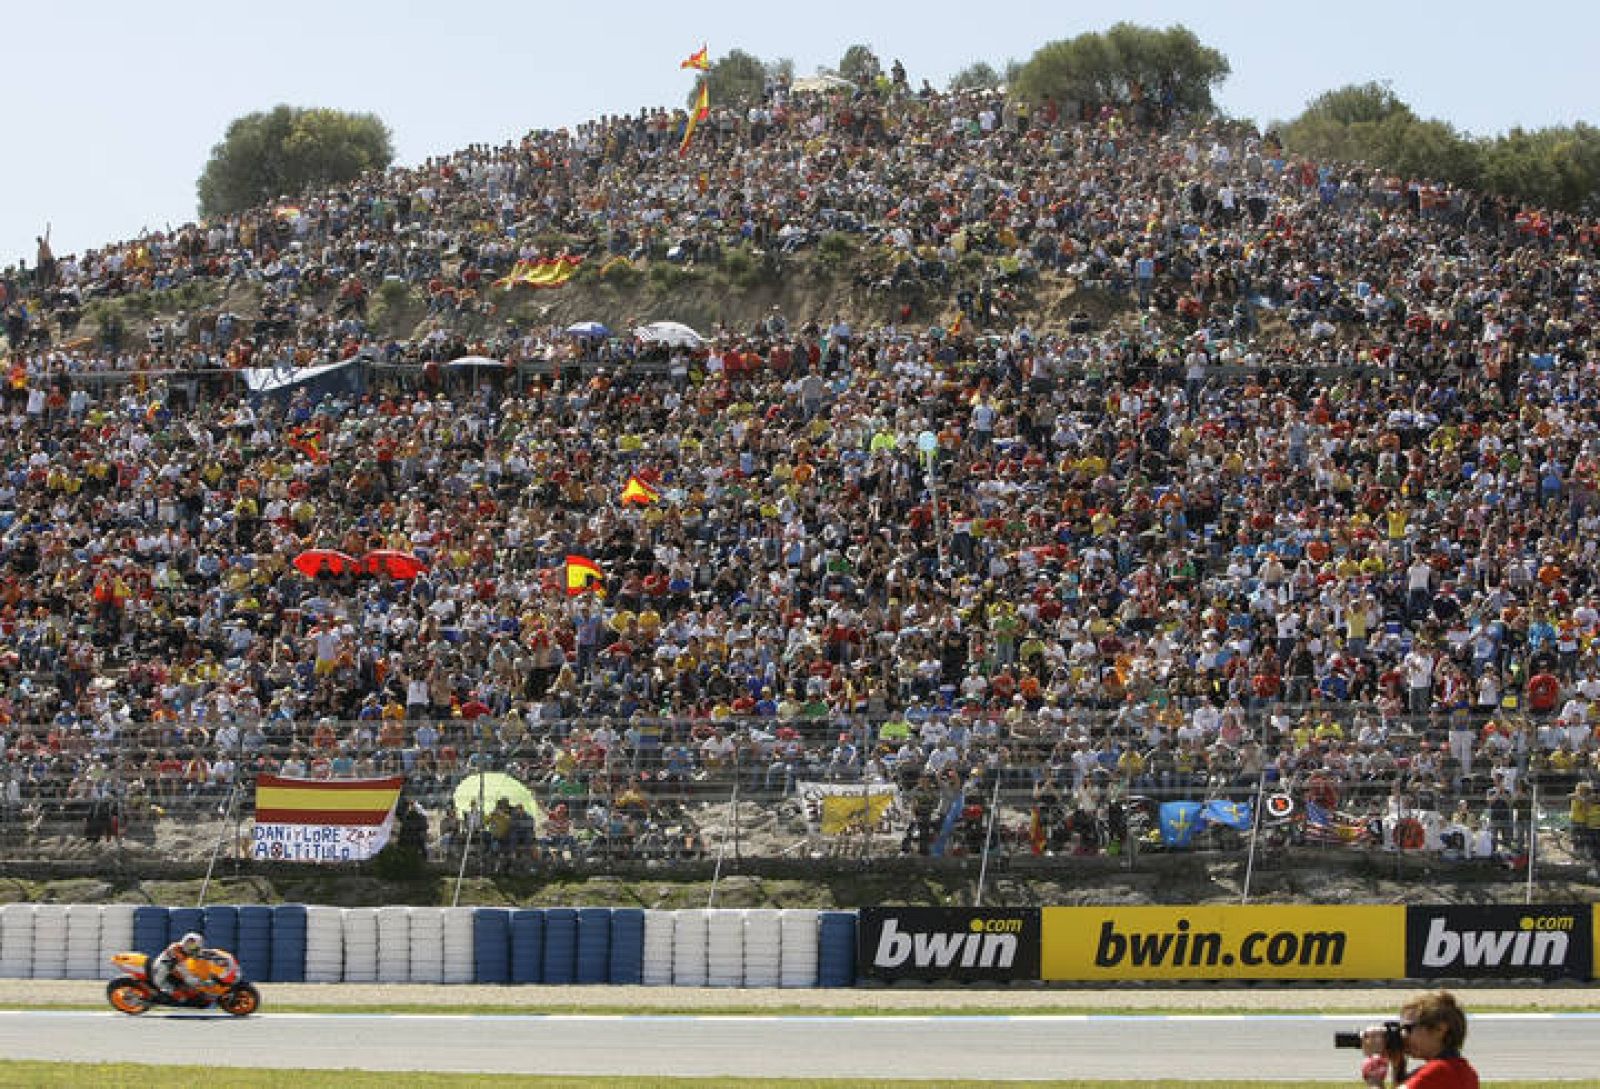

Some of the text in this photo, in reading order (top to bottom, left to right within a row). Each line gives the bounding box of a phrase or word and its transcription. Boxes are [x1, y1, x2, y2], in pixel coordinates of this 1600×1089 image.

[873, 918, 1018, 967] bwin
[1095, 919, 1347, 967] bwin.com
[1422, 917, 1569, 967] bwin
